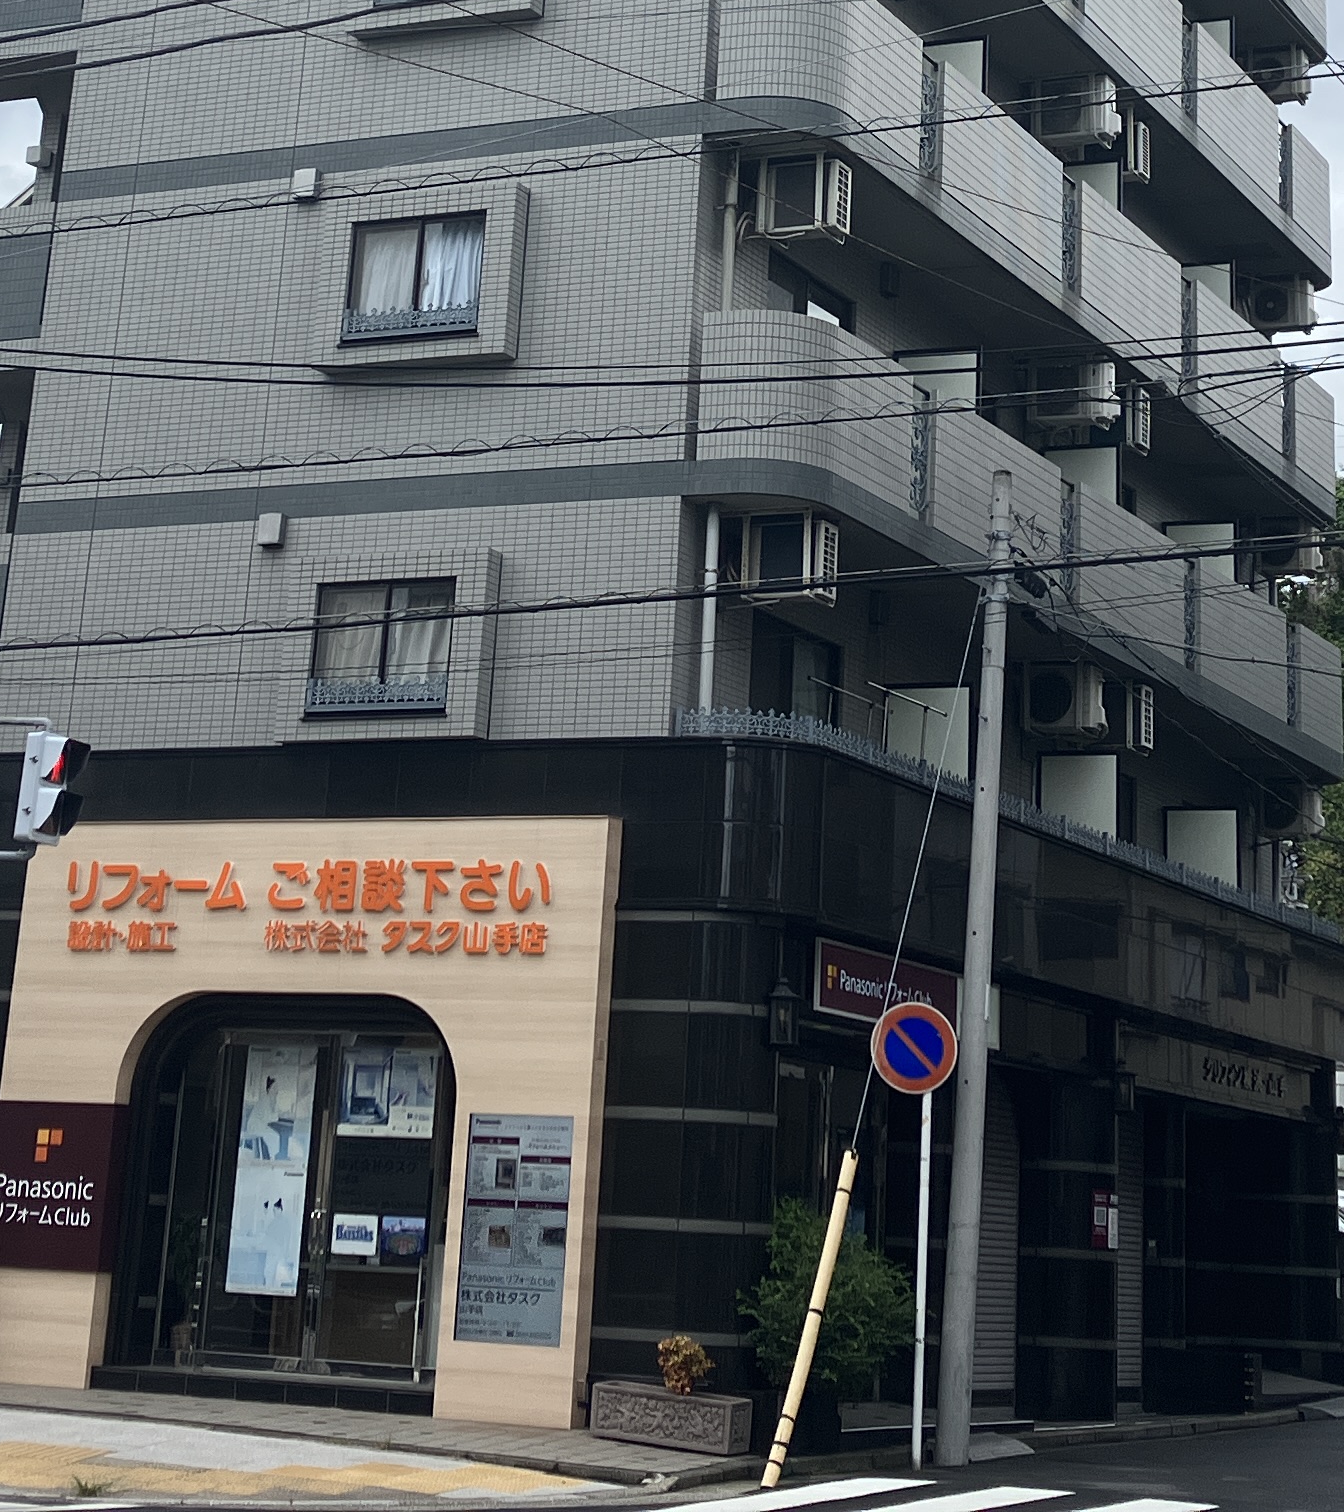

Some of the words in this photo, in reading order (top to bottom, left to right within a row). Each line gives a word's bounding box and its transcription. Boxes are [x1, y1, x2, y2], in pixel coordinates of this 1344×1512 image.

[67, 860, 247, 912] リフォーム
[267, 858, 552, 913] ご相談下さい
[66, 920, 178, 952] 設計・施工
[263, 919, 369, 953] 株式会社
[381, 919, 550, 955] タスク山手店
[840, 969, 884, 1000] Panasonic
[461, 1289, 541, 1306] 株式会社タスク
